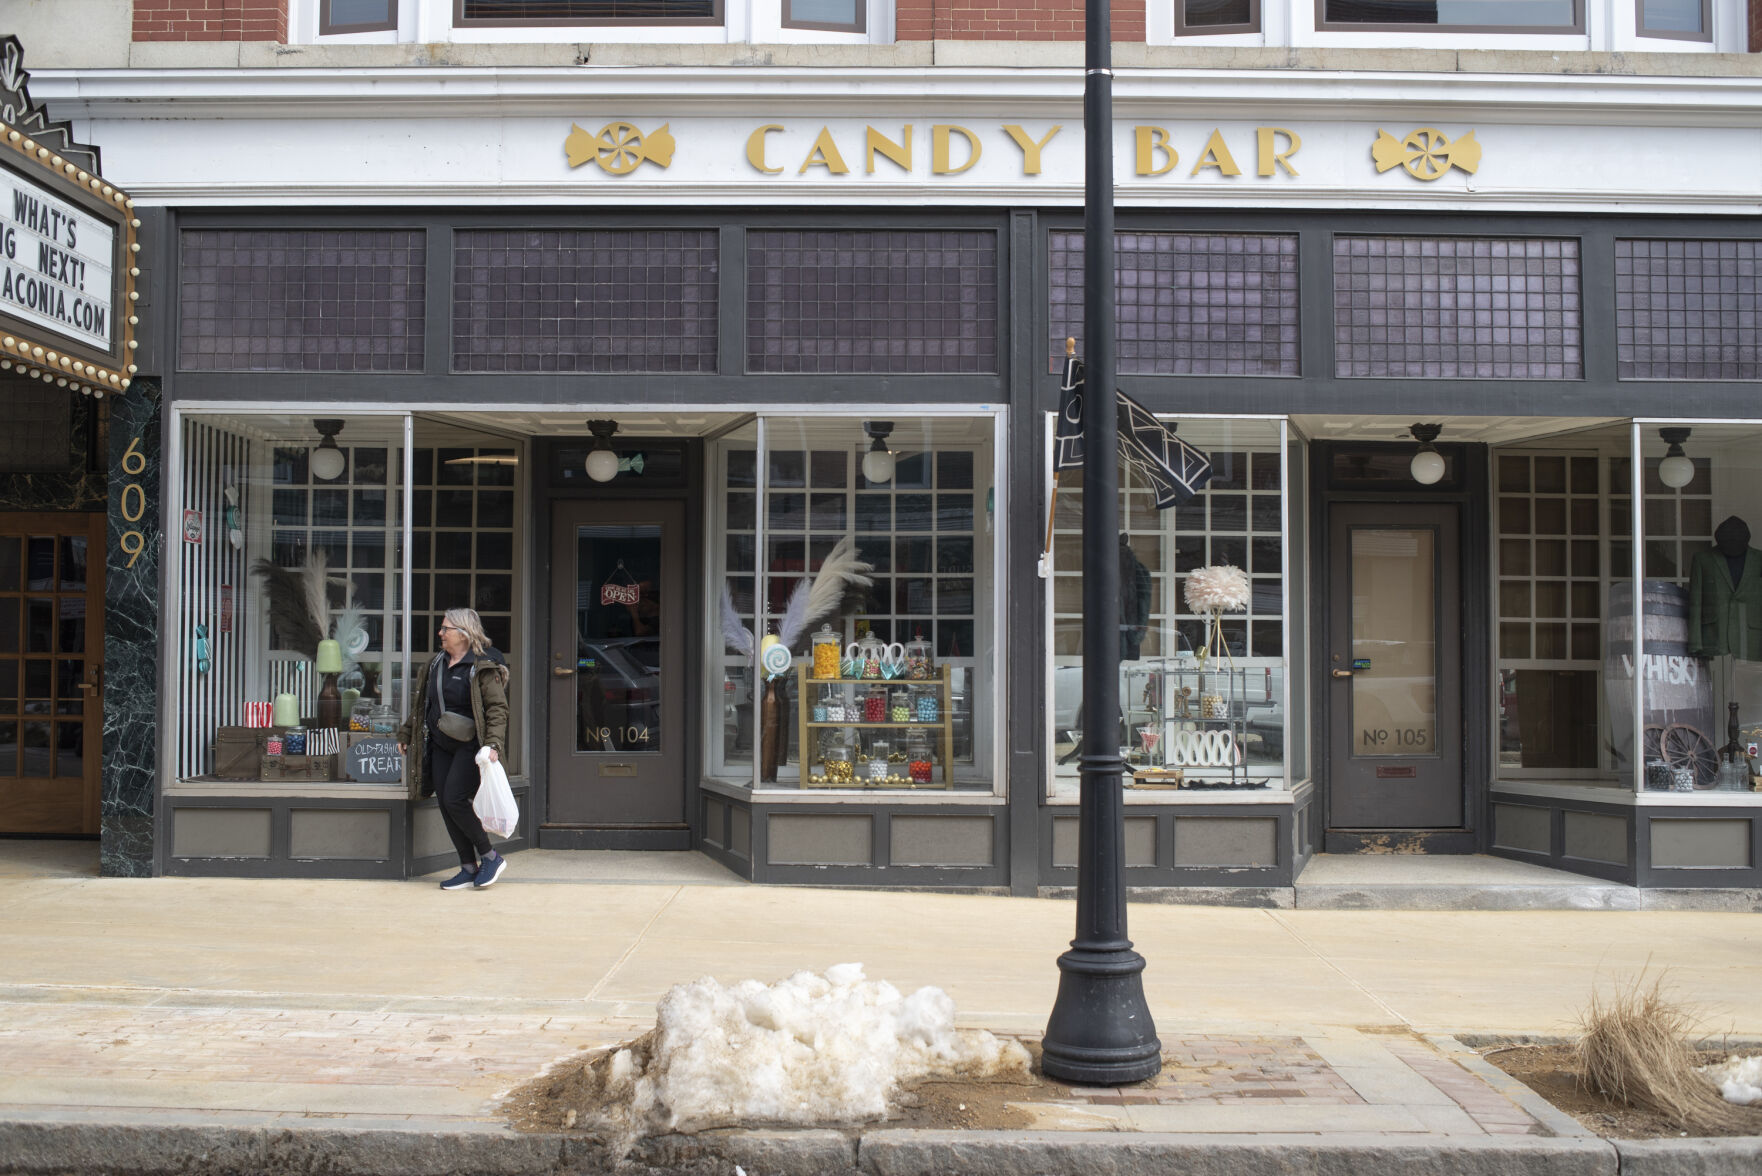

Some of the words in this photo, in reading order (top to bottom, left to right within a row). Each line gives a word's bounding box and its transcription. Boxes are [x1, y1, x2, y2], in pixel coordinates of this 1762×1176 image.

[745, 123, 1064, 176] CANDY
[1134, 125, 1303, 177] BAR
[13, 188, 77, 250] WHAT'S
[38, 241, 86, 291] NEXT!
[2, 266, 106, 337] ACONIA.COM
[120, 437, 146, 569] 609
[605, 590, 636, 602] OPEN
[618, 726, 650, 743] 104
[1395, 728, 1427, 746] 105
